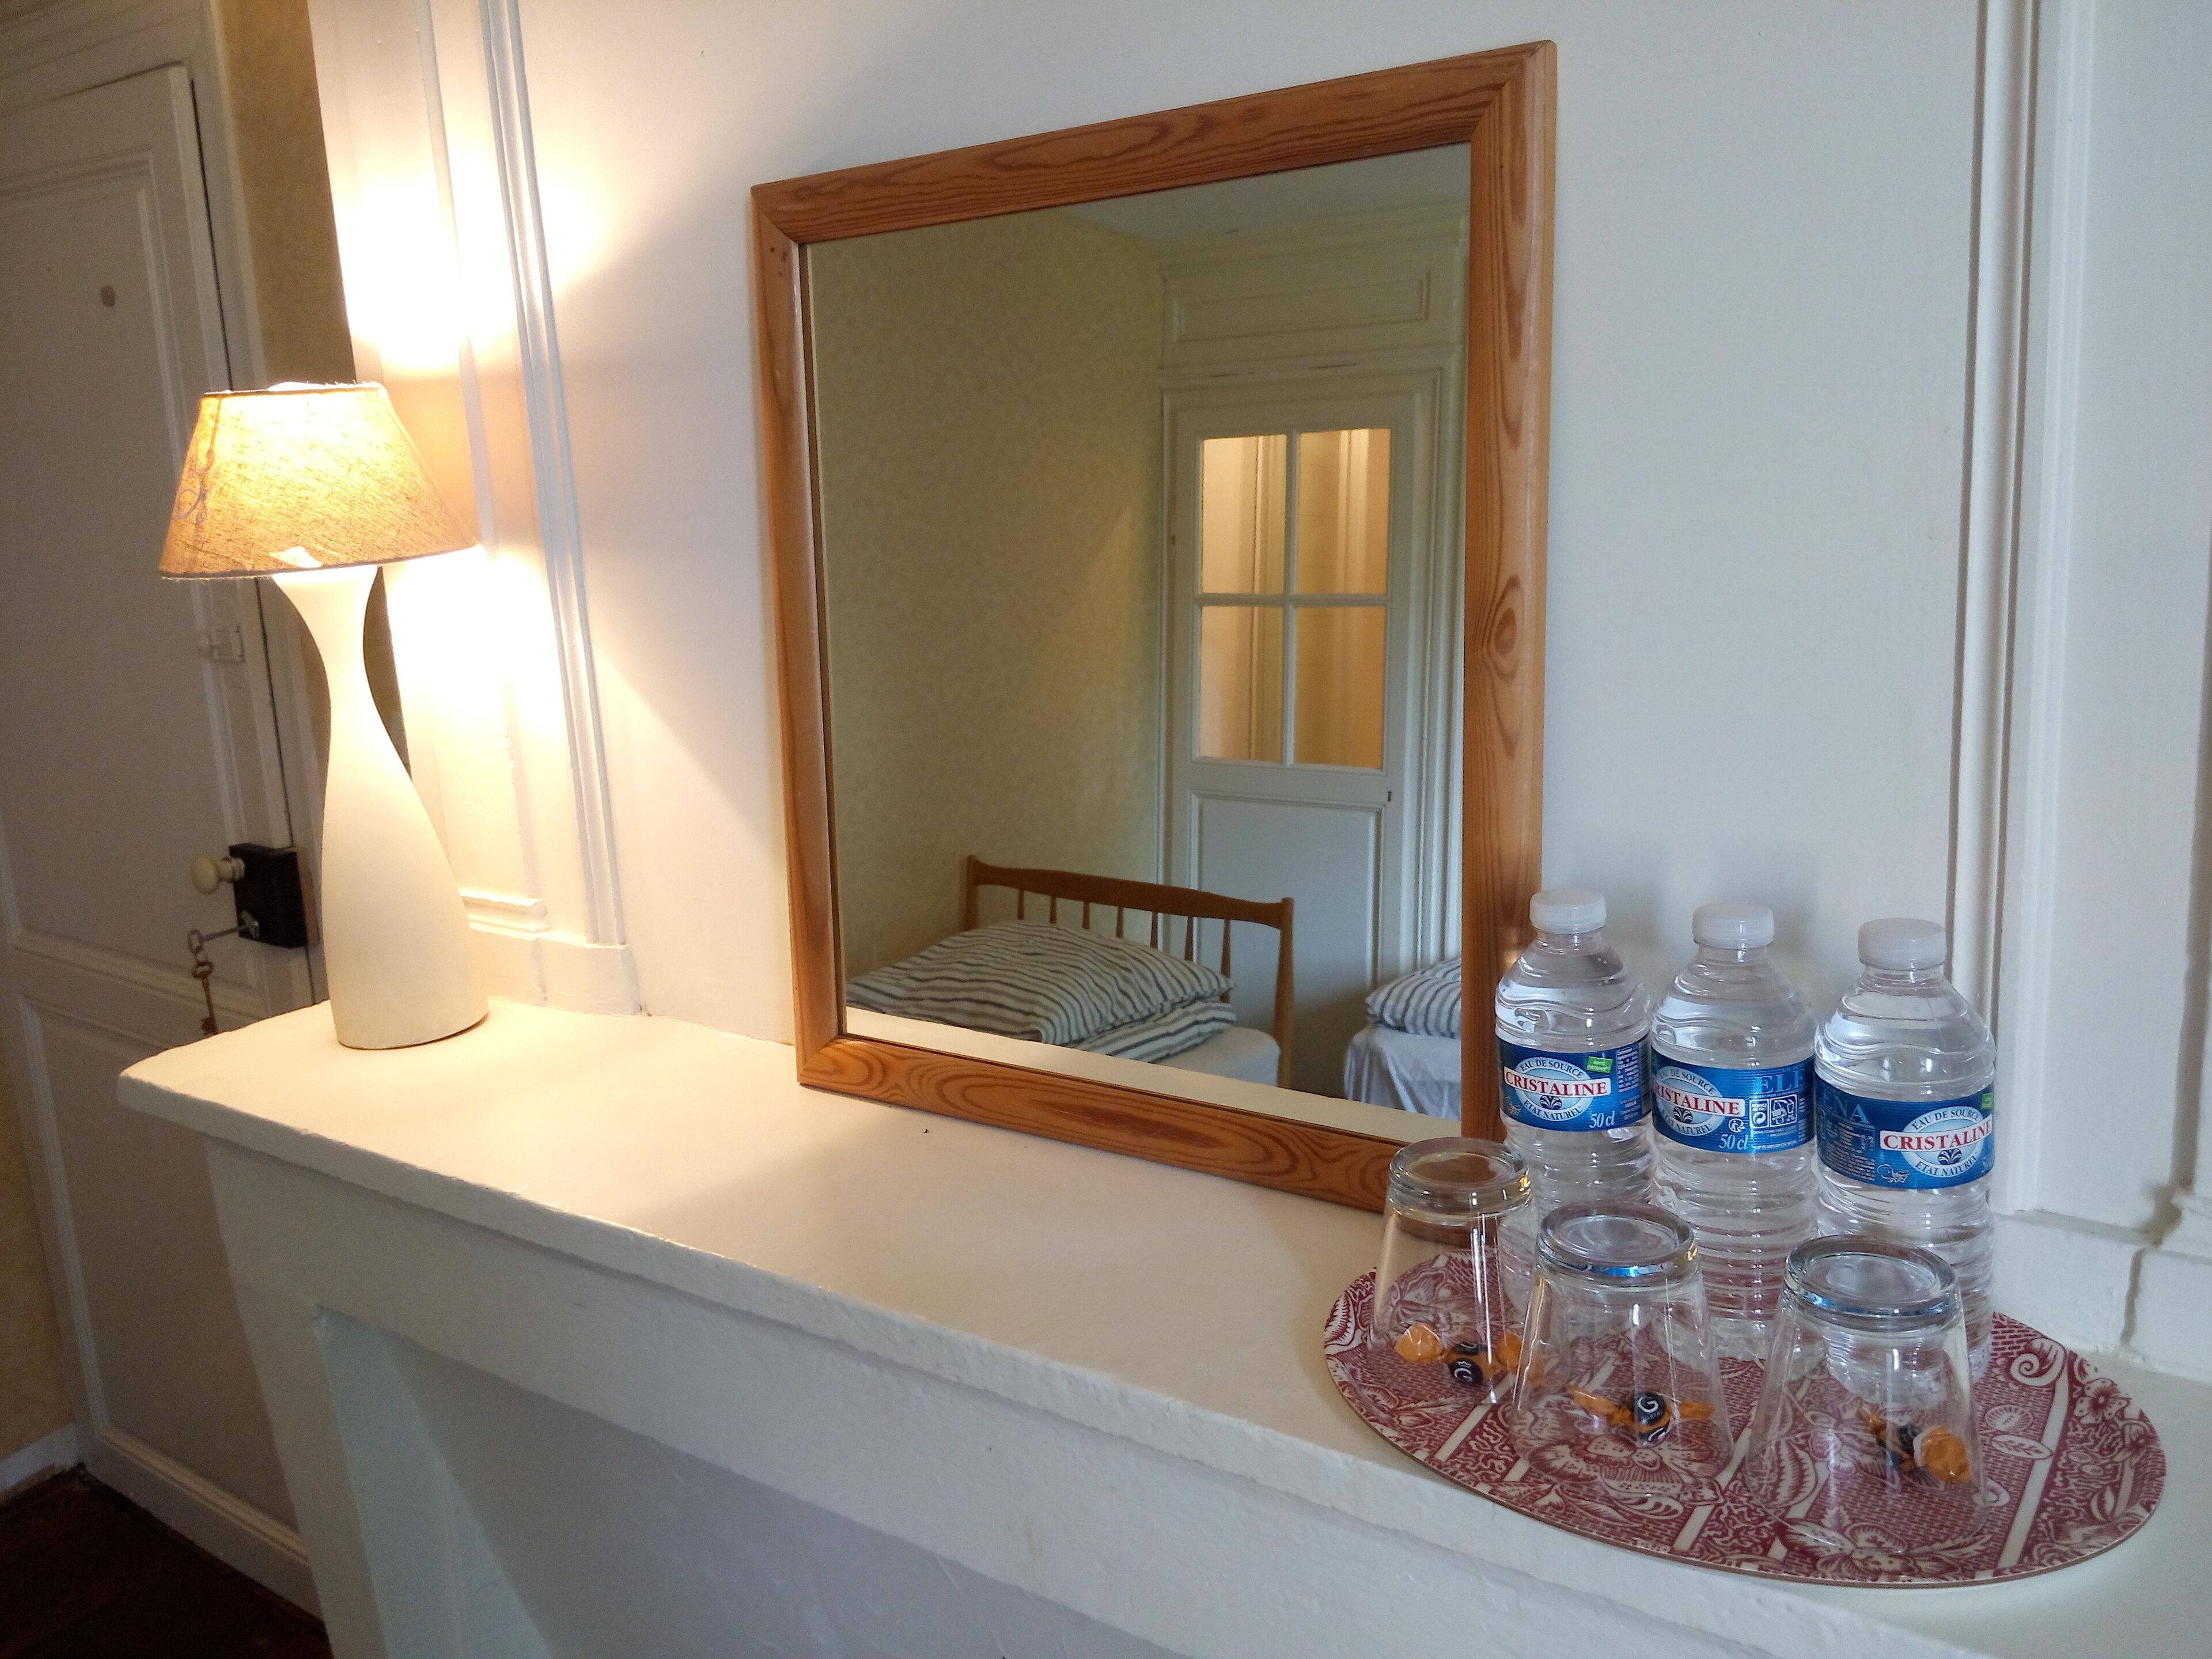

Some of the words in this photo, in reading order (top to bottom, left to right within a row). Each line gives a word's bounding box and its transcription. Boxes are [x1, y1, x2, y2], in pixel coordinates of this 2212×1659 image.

[1520, 1060, 1534, 1071] EAU
[1536, 1059, 1547, 1067] DE
[1548, 1060, 1584, 1079] SOURCE
[1505, 1071, 1608, 1096] CRISTALINE
[1671, 1070, 1680, 1078] DE
[1681, 1071, 1715, 1095] SOURCE
[1652, 1079, 1740, 1115] RISTALINE
[1524, 1099, 1543, 1116] ETAT
[1543, 1107, 1582, 1121] NATUREL
[1589, 1112, 1604, 1128] 50
[1605, 1110, 1616, 1127] cl
[1912, 1116, 1932, 1130] EAU
[1934, 1111, 1948, 1120] DE
[1951, 1108, 1980, 1121] SOURCE
[1718, 1134, 1736, 1150] 50
[1736, 1134, 1748, 1150] cl
[1883, 1119, 1991, 1150] CRISTALINE
[1915, 1161, 1940, 1176] ETAT
